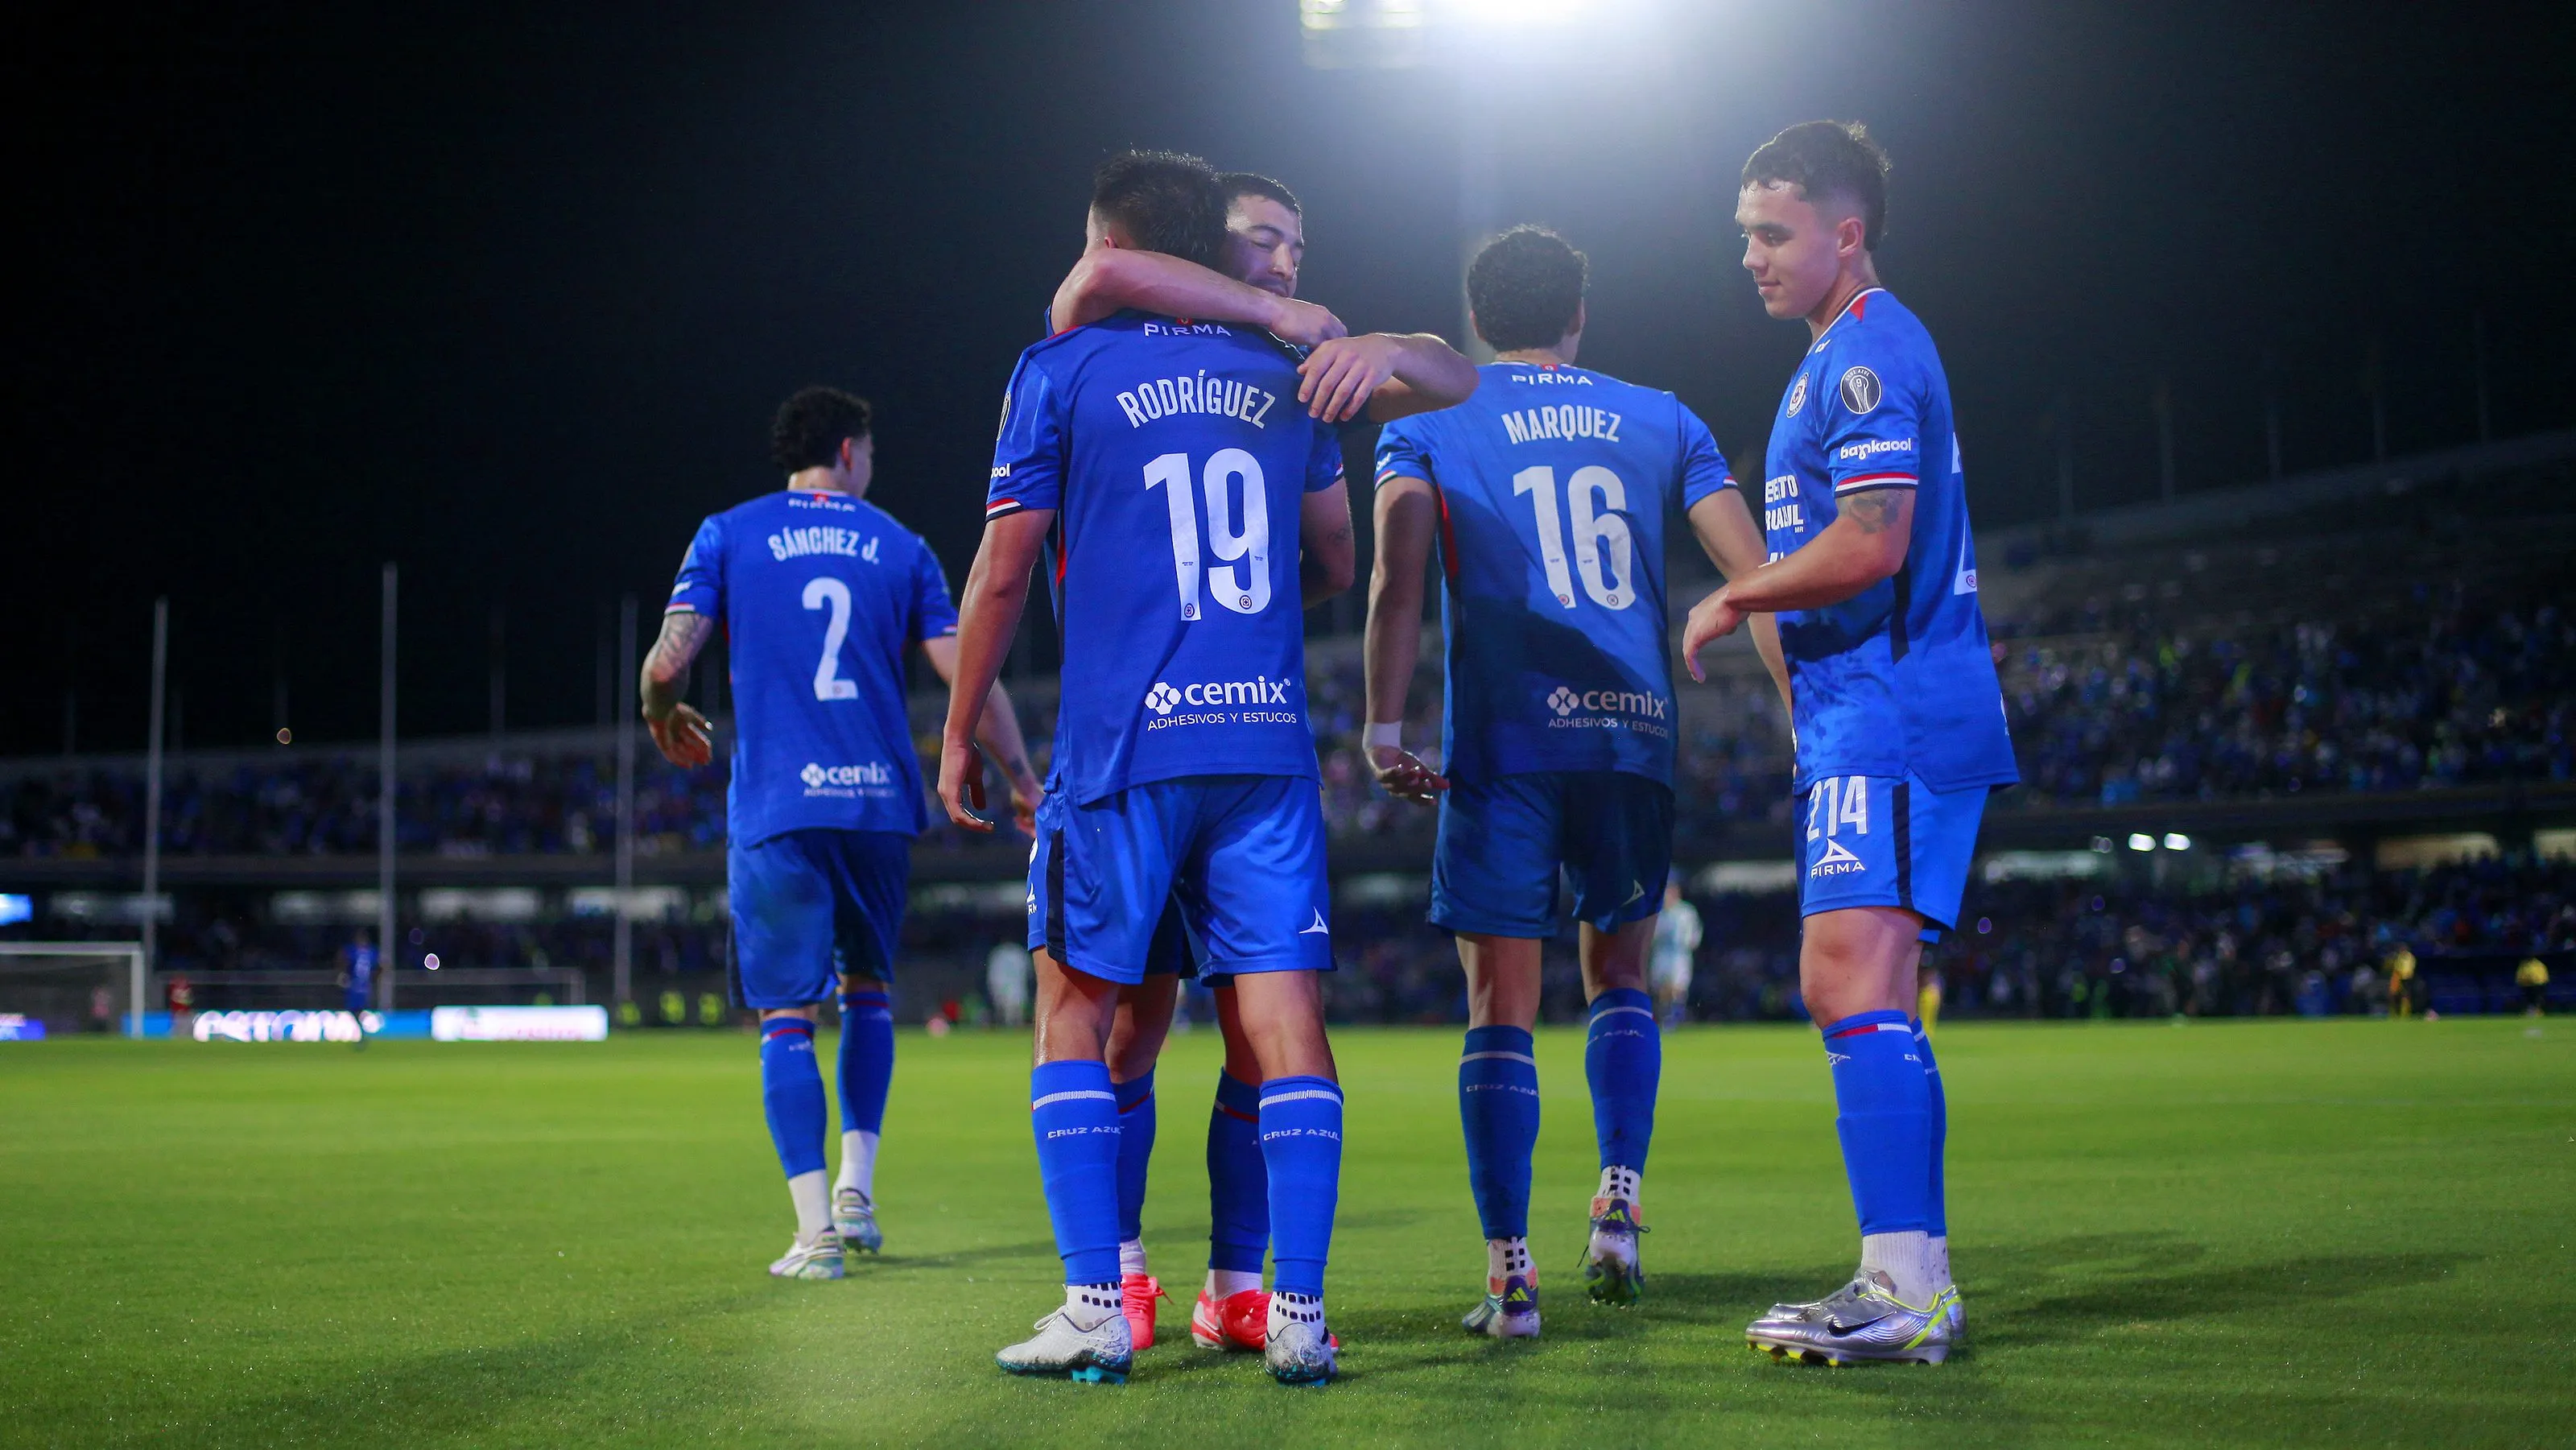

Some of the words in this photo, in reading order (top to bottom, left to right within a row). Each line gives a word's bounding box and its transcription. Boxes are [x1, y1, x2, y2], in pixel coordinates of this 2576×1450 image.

[1144, 323, 1232, 337] PIRMA
[1512, 373, 1593, 386] PIRMA
[1116, 370, 1276, 429] RODRÍGUEZ
[1501, 404, 1621, 445] MARQUEZ
[991, 463, 1011, 478] ool
[767, 526, 861, 562] SÁNCHEZ
[1143, 448, 1271, 621] 19
[1513, 465, 1637, 610] 16
[802, 576, 858, 701] 2
[1184, 675, 1287, 706] cemix
[1583, 691, 1666, 720] cemix
[1147, 713, 1225, 731] ADHESIVOS
[1229, 713, 1238, 723] Y
[1243, 712, 1297, 723] ESTUCOS
[1548, 717, 1618, 729] ADHESIVOS
[1622, 720, 1629, 729] Y
[1806, 775, 1868, 843] 214
[1811, 861, 1867, 878] PIRMA
[1047, 1127, 1088, 1139] CRUZ
[1263, 1129, 1302, 1142] CRUZ
[1306, 1129, 1341, 1142] AZUL
